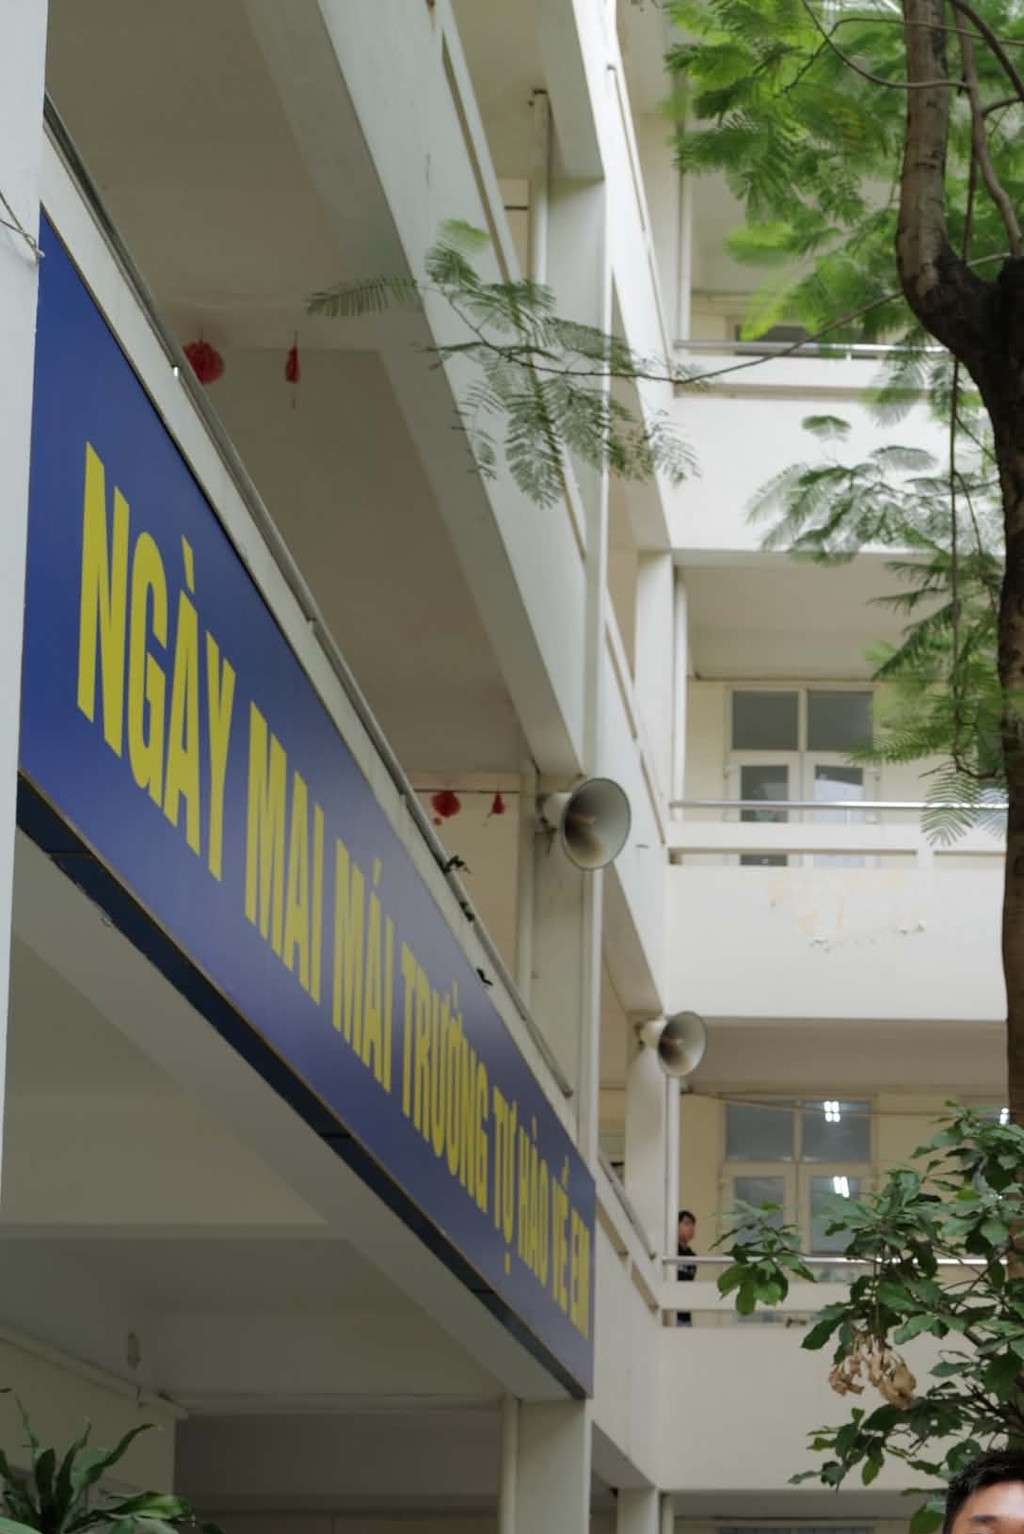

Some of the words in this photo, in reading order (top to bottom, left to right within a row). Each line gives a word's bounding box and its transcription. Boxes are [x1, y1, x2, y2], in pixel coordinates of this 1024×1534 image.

[77, 440, 236, 883] NGÀY
[244, 700, 324, 1007] MAI
[332, 837, 394, 1093] MÁI
[402, 940, 488, 1214] TRƯỜNG
[493, 1084, 517, 1276] TỰ
[518, 1115, 548, 1288] HÀO
[570, 1206, 590, 1341] EM
